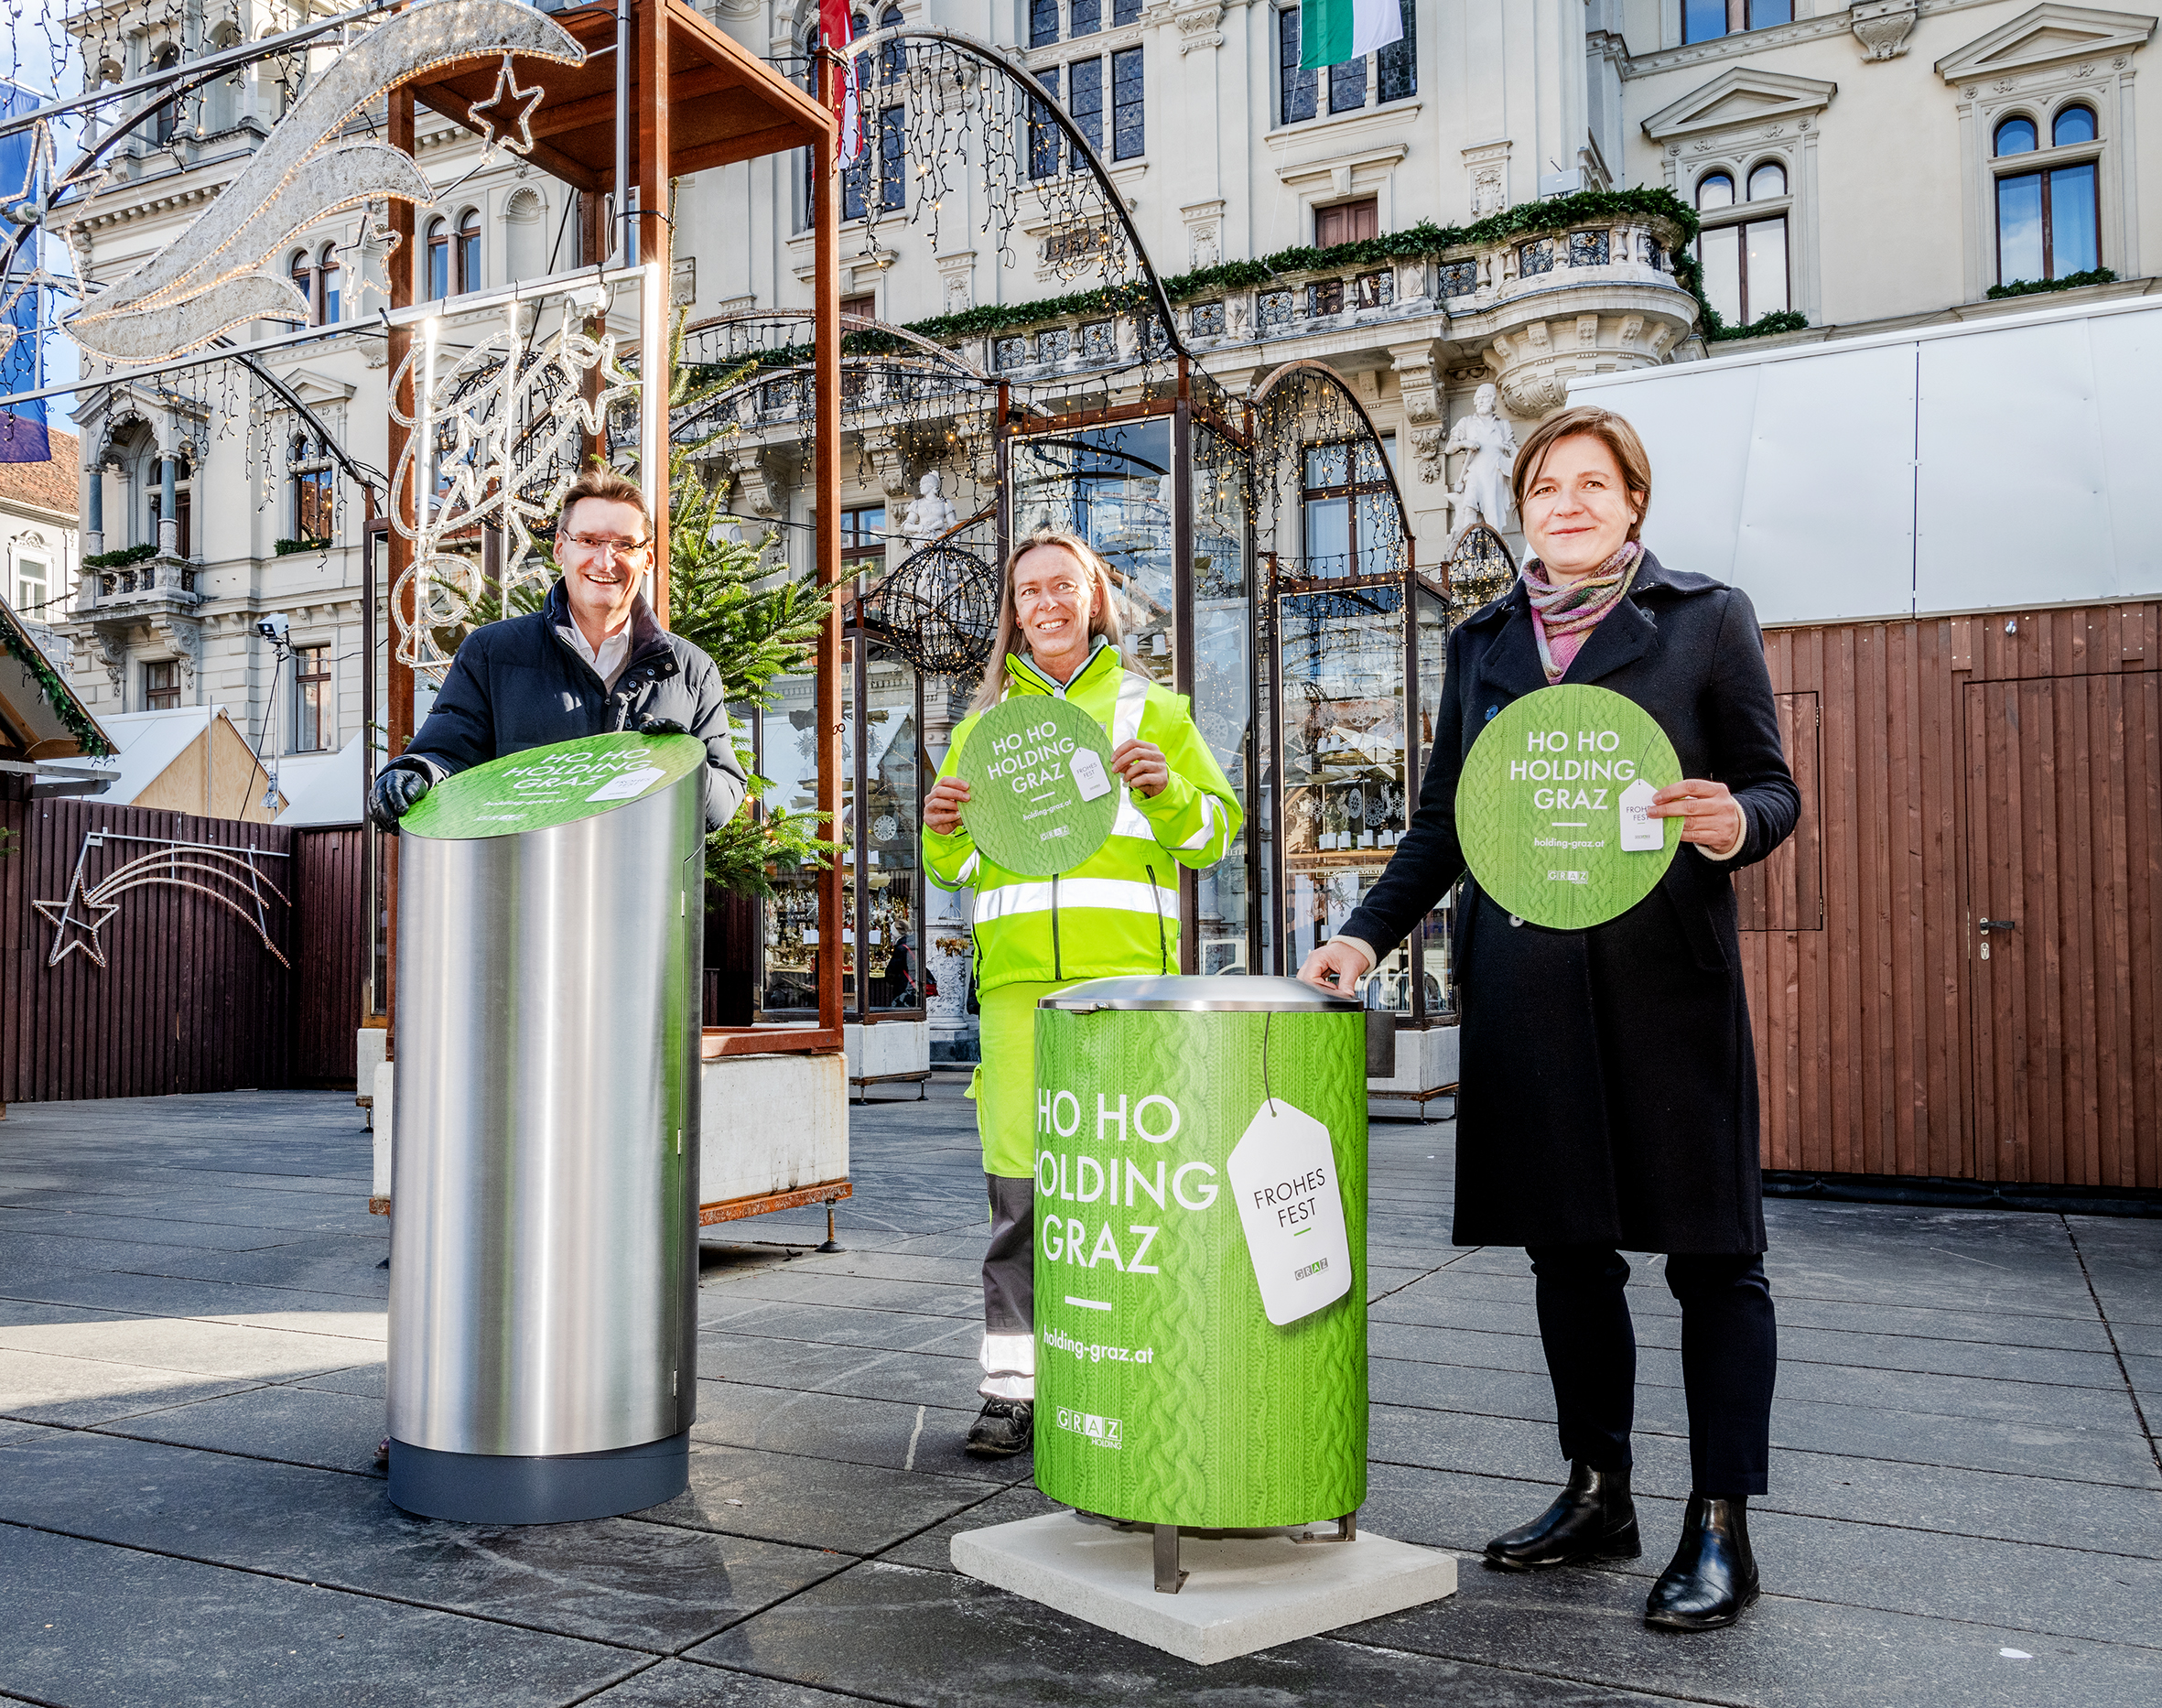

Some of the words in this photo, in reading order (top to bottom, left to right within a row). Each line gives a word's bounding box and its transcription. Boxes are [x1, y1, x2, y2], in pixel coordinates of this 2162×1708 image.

[992, 733, 1022, 756] HO
[1026, 721, 1056, 743] HO
[1528, 730, 1569, 751] HO
[1577, 730, 1619, 752] HO
[540, 751, 594, 764] HO
[597, 749, 652, 762] HO
[987, 737, 1075, 780] HOLDING
[502, 760, 654, 778] HOLDING
[1011, 762, 1065, 794] GRAZ
[1510, 759, 1636, 781] HOLDING
[513, 774, 608, 790] GRAZ
[1022, 799, 1072, 821] holding-graz.at
[1533, 788, 1608, 810] GRAZ
[1626, 805, 1650, 814] FROH
[1534, 837, 1605, 849] holding-graz.at
[1548, 870, 1587, 881] GRAZ
[1038, 1088, 1080, 1137] HO
[1097, 1093, 1180, 1143] HO
[1253, 1168, 1326, 1209] FROHES
[1277, 1197, 1316, 1228] FEST
[1043, 1214, 1159, 1274] GRAZ
[1295, 1258, 1327, 1281] GRAZ
[1043, 1324, 1154, 1363] holding-graz.at
[1057, 1407, 1119, 1440] GRAZ
[1091, 1438, 1122, 1450] HOLDING
